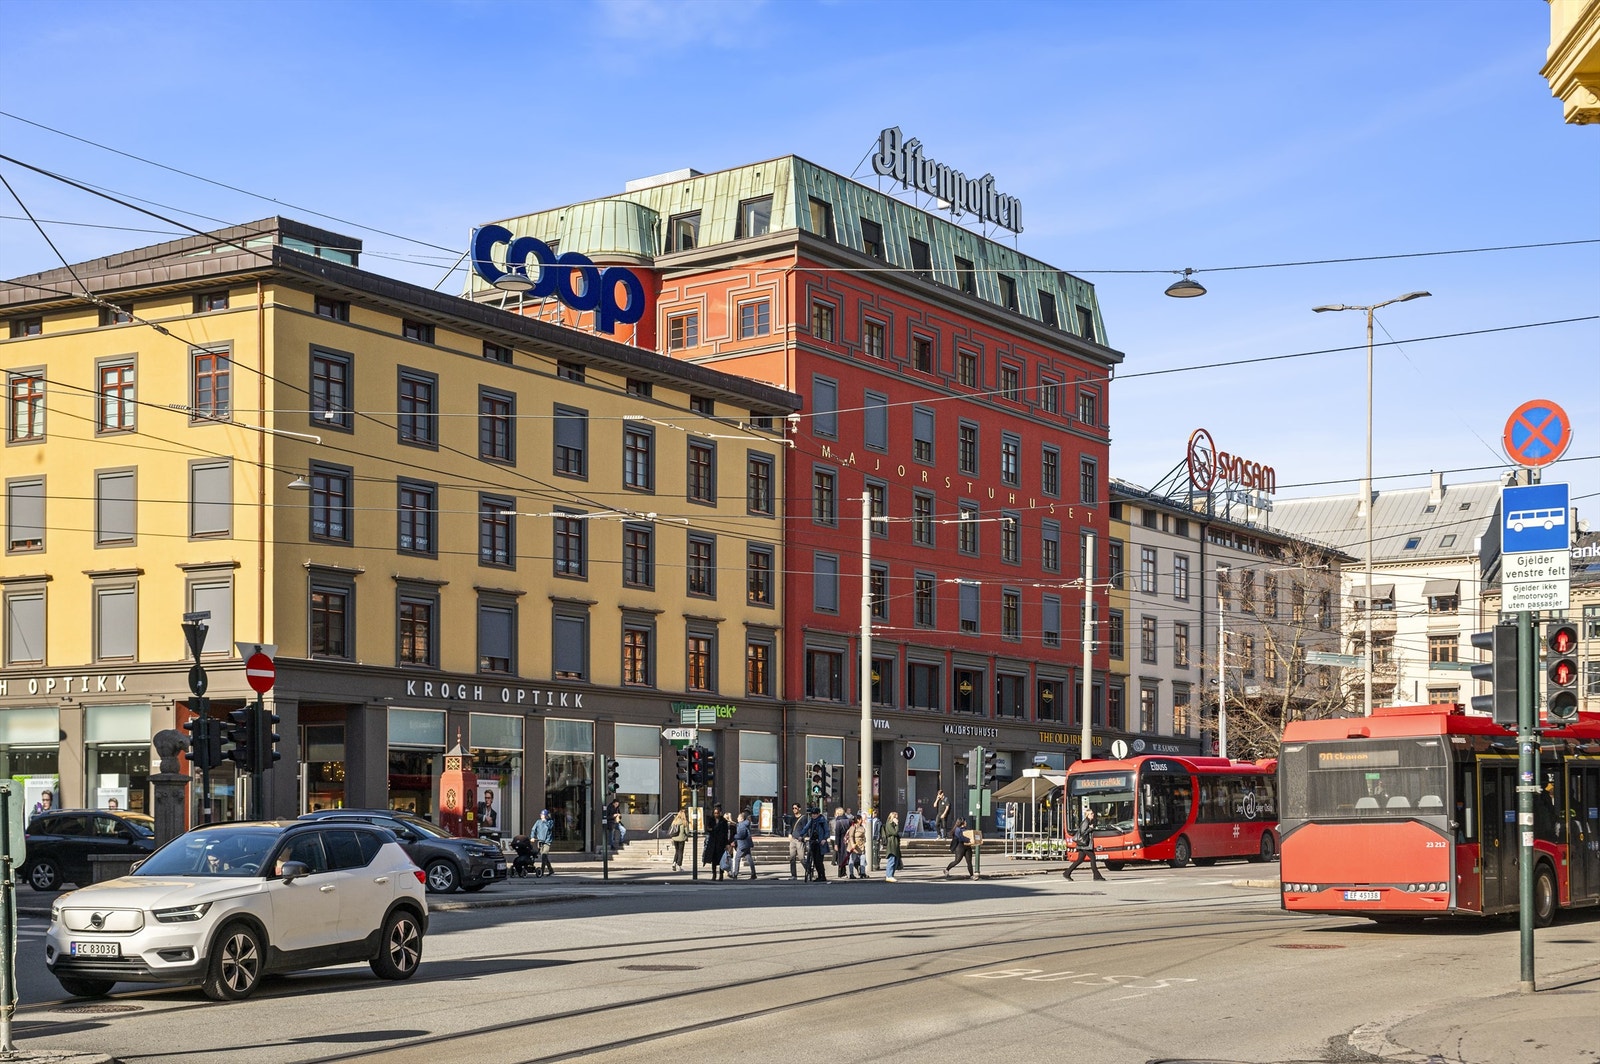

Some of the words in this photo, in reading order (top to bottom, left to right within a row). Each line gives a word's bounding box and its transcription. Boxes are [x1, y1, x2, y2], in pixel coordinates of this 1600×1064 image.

[872, 126, 1024, 233] Aftenposten
[1218, 452, 1275, 495] SYNSAM
[822, 445, 1093, 523] MAJORSTUHUSET
[1517, 555, 1554, 567] Gjelder
[1506, 568, 1544, 578] venstre
[1548, 566, 1566, 576] felt
[1513, 584, 1540, 593] Gjelder
[1512, 592, 1558, 600] elmotorvogn
[1527, 600, 1562, 609] passasjer
[28, 675, 126, 696] OPTIKK
[407, 680, 482, 700] KROGH
[501, 688, 583, 708] OPTIKK
[873, 719, 890, 729] VITA
[671, 730, 691, 738] Politi
[944, 724, 998, 738] MAJORSTUHUSET
[1039, 731, 1053, 743] THE
[1054, 733, 1068, 744] OLD
[1150, 761, 1168, 771] Elbuss
[1349, 891, 1357, 899] EF
[77, 944, 87, 953] EC
[90, 944, 116, 954] 83036
[964, 968, 1198, 989] BUSS
